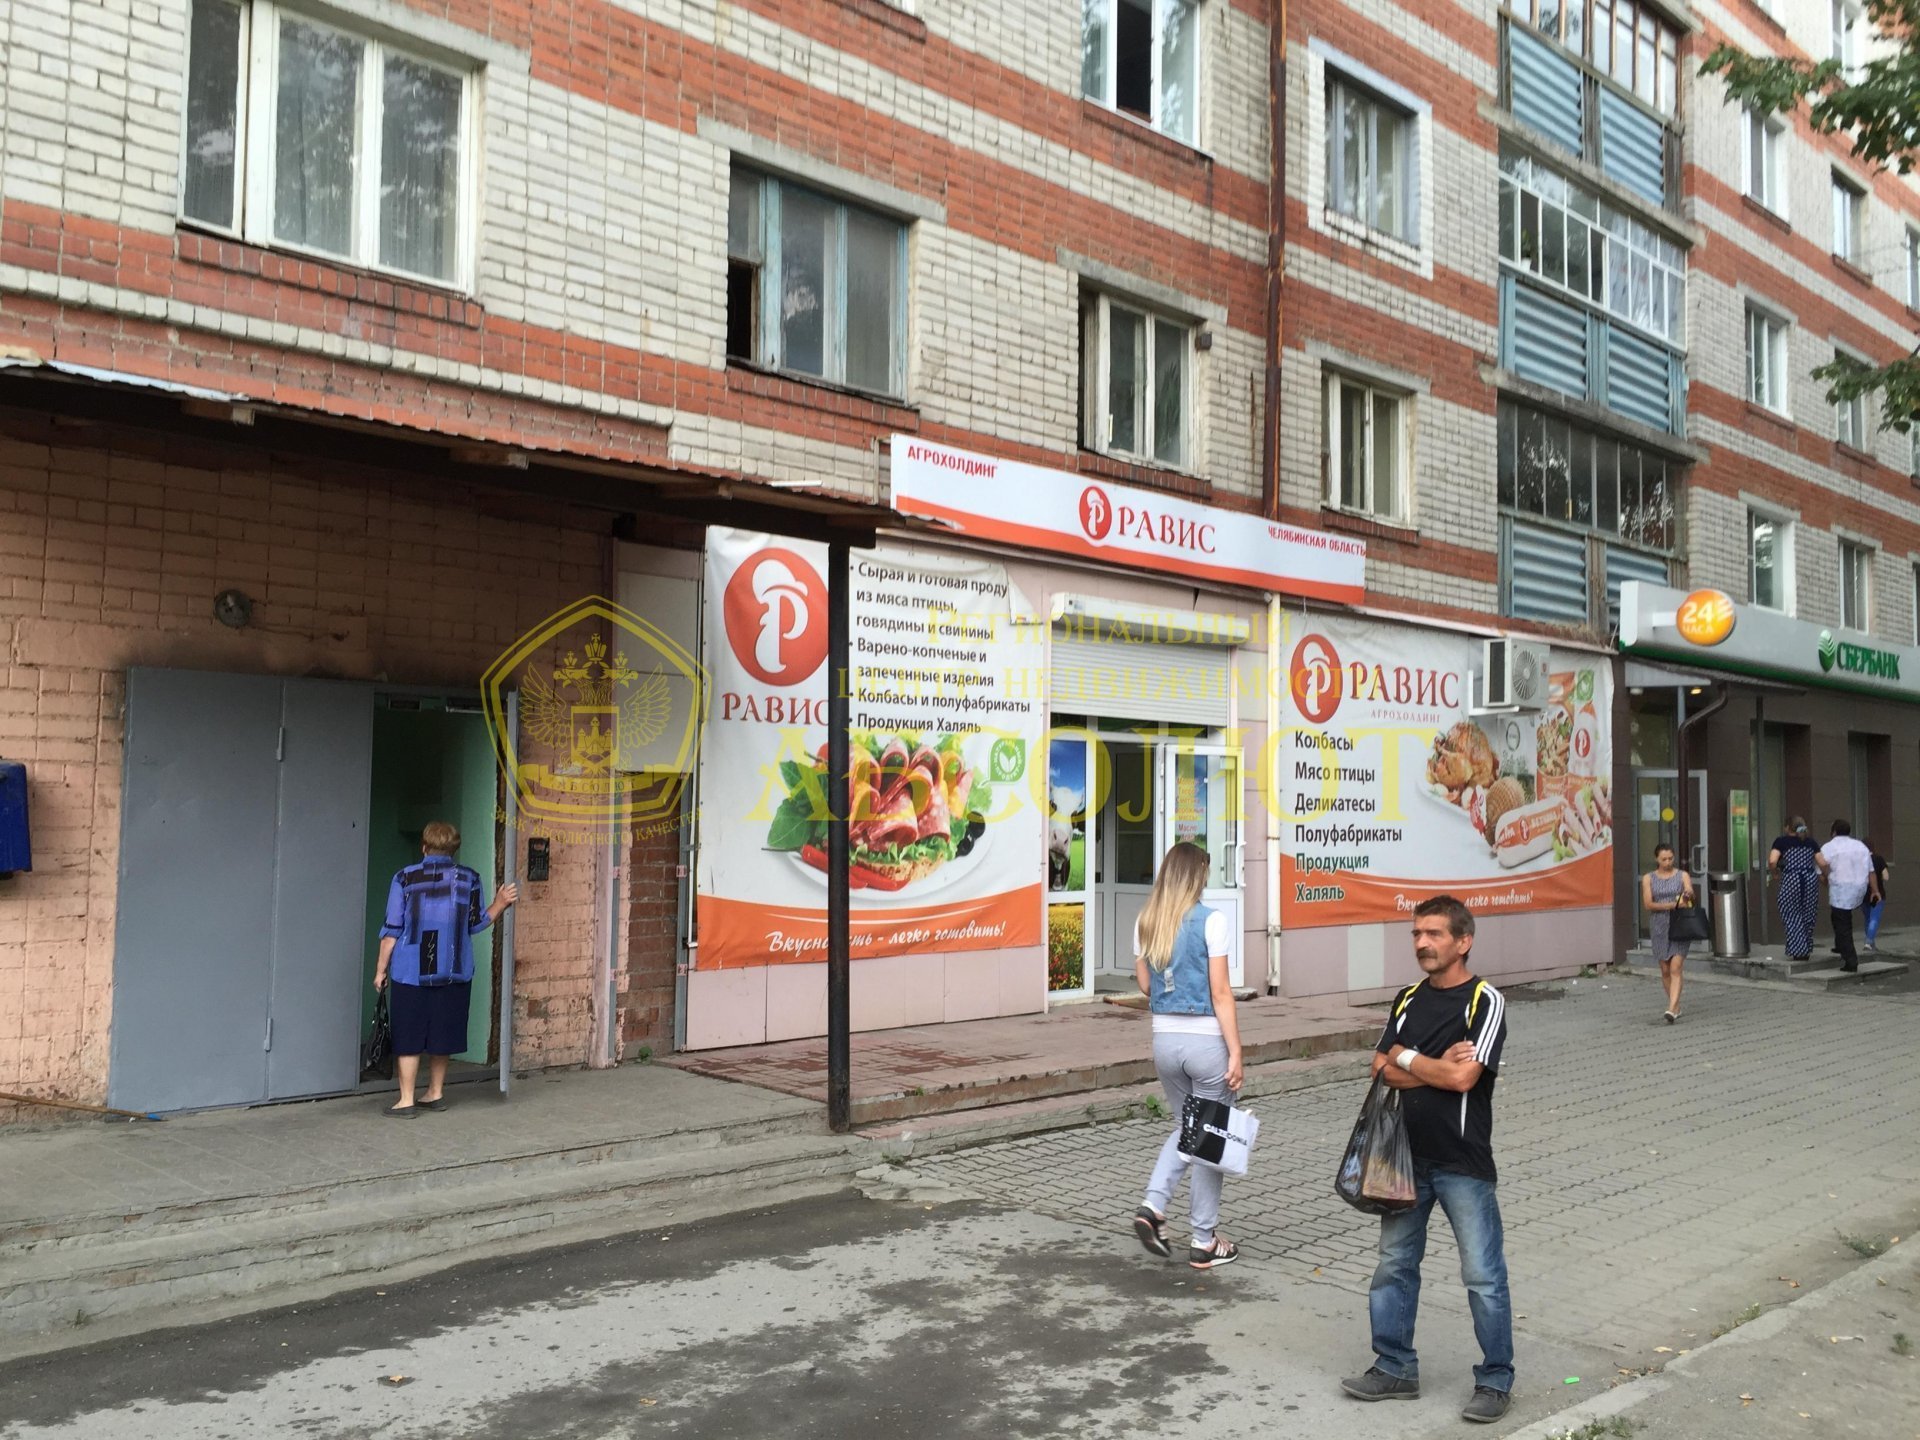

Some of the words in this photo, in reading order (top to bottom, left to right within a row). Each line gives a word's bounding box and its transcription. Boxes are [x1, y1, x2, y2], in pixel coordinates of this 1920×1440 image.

[908, 445, 998, 478] АГРОХОЛДИНГ
[1117, 505, 1216, 554] РАВИС
[1268, 525, 1327, 549] ЧЕЛЯБИНСКАЯ
[1329, 538, 1367, 557] ОБЛАСТЬ
[858, 562, 904, 583] Сырая
[907, 573, 916, 583] и
[919, 573, 968, 591] готовая
[970, 579, 1008, 599] проду
[856, 590, 872, 603] из
[876, 594, 909, 608] мяса
[912, 598, 958, 614] птицы,
[1682, 602, 1714, 623] 24
[857, 615, 925, 633] говядины
[928, 625, 936, 634] и
[938, 624, 994, 640] свинины
[1682, 623, 1714, 634] ЧАСА
[858, 637, 976, 662] Варено-копченые
[979, 653, 987, 663] и
[1836, 642, 1901, 680] СБЕРБАНК
[858, 665, 940, 683] запеченные
[943, 673, 994, 688] изделия
[1349, 661, 1459, 709] РАВИС
[858, 688, 918, 705] Колбасы
[921, 696, 929, 706] и
[932, 695, 1031, 713] полуфабрикаты
[857, 713, 933, 732] Продукция
[936, 717, 981, 733] Халяль
[1370, 708, 1441, 723] АГРОХОЛДИНГ
[1295, 731, 1354, 751] Колбасы
[1295, 762, 1331, 781] Мясо
[1334, 768, 1375, 785] птицы
[1295, 793, 1375, 815] Деликатесы
[1295, 825, 1402, 849] Полуфабрикаты
[1295, 853, 1369, 875] Продукция
[1295, 883, 1345, 903] Халяль
[1464, 894, 1489, 908] легко
[888, 928, 930, 945] легко
[934, 920, 1007, 941] готовить!
